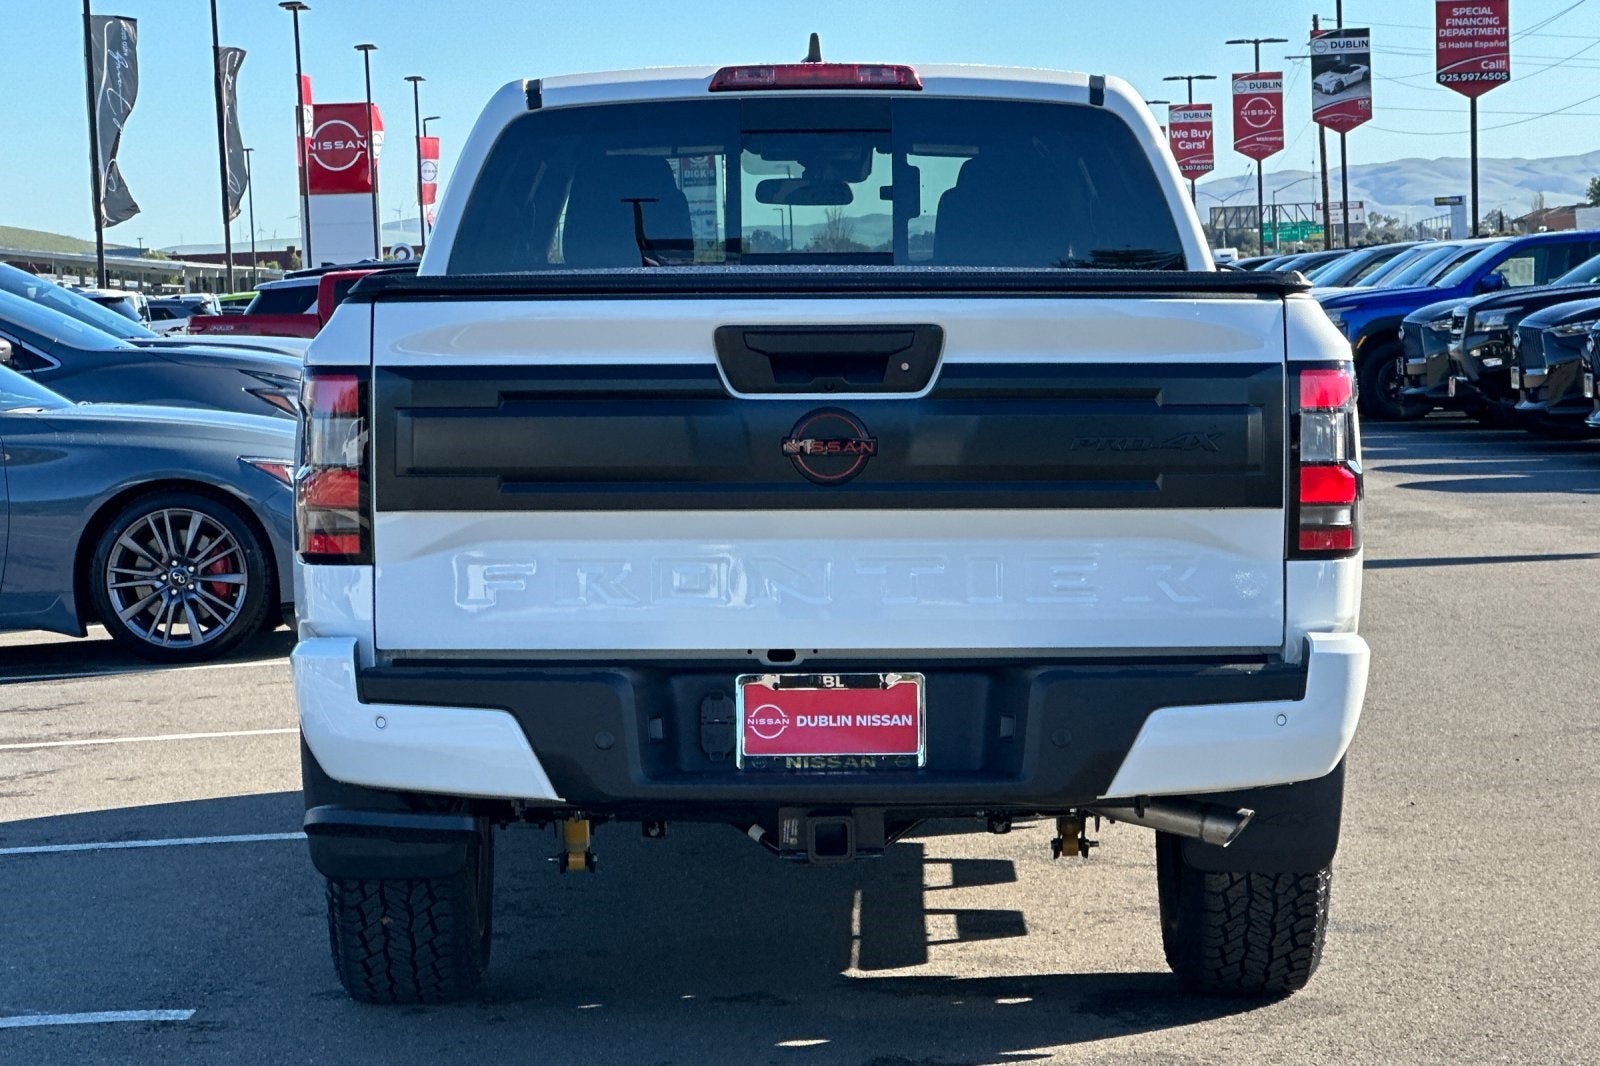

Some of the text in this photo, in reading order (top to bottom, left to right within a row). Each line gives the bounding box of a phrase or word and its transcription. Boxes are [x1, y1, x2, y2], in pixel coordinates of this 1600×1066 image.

[1452, 7, 1493, 16] SPECIAL
[1445, 17, 1500, 26] FINANCING
[1439, 28, 1506, 37] DEPARTMENT
[1330, 40, 1369, 49] DUBLIN
[1481, 60, 1505, 70] Call!
[1440, 72, 1508, 82] 925.997.4505
[1171, 129, 1212, 140] We Buy
[309, 139, 367, 150] NISSAN
[1178, 141, 1206, 150] Cars!
[783, 440, 876, 453] NISSAN
[451, 551, 1202, 611] FRONTIER
[796, 715, 912, 727] DUBLIN NISSAN
[785, 755, 877, 769] NISSAN
